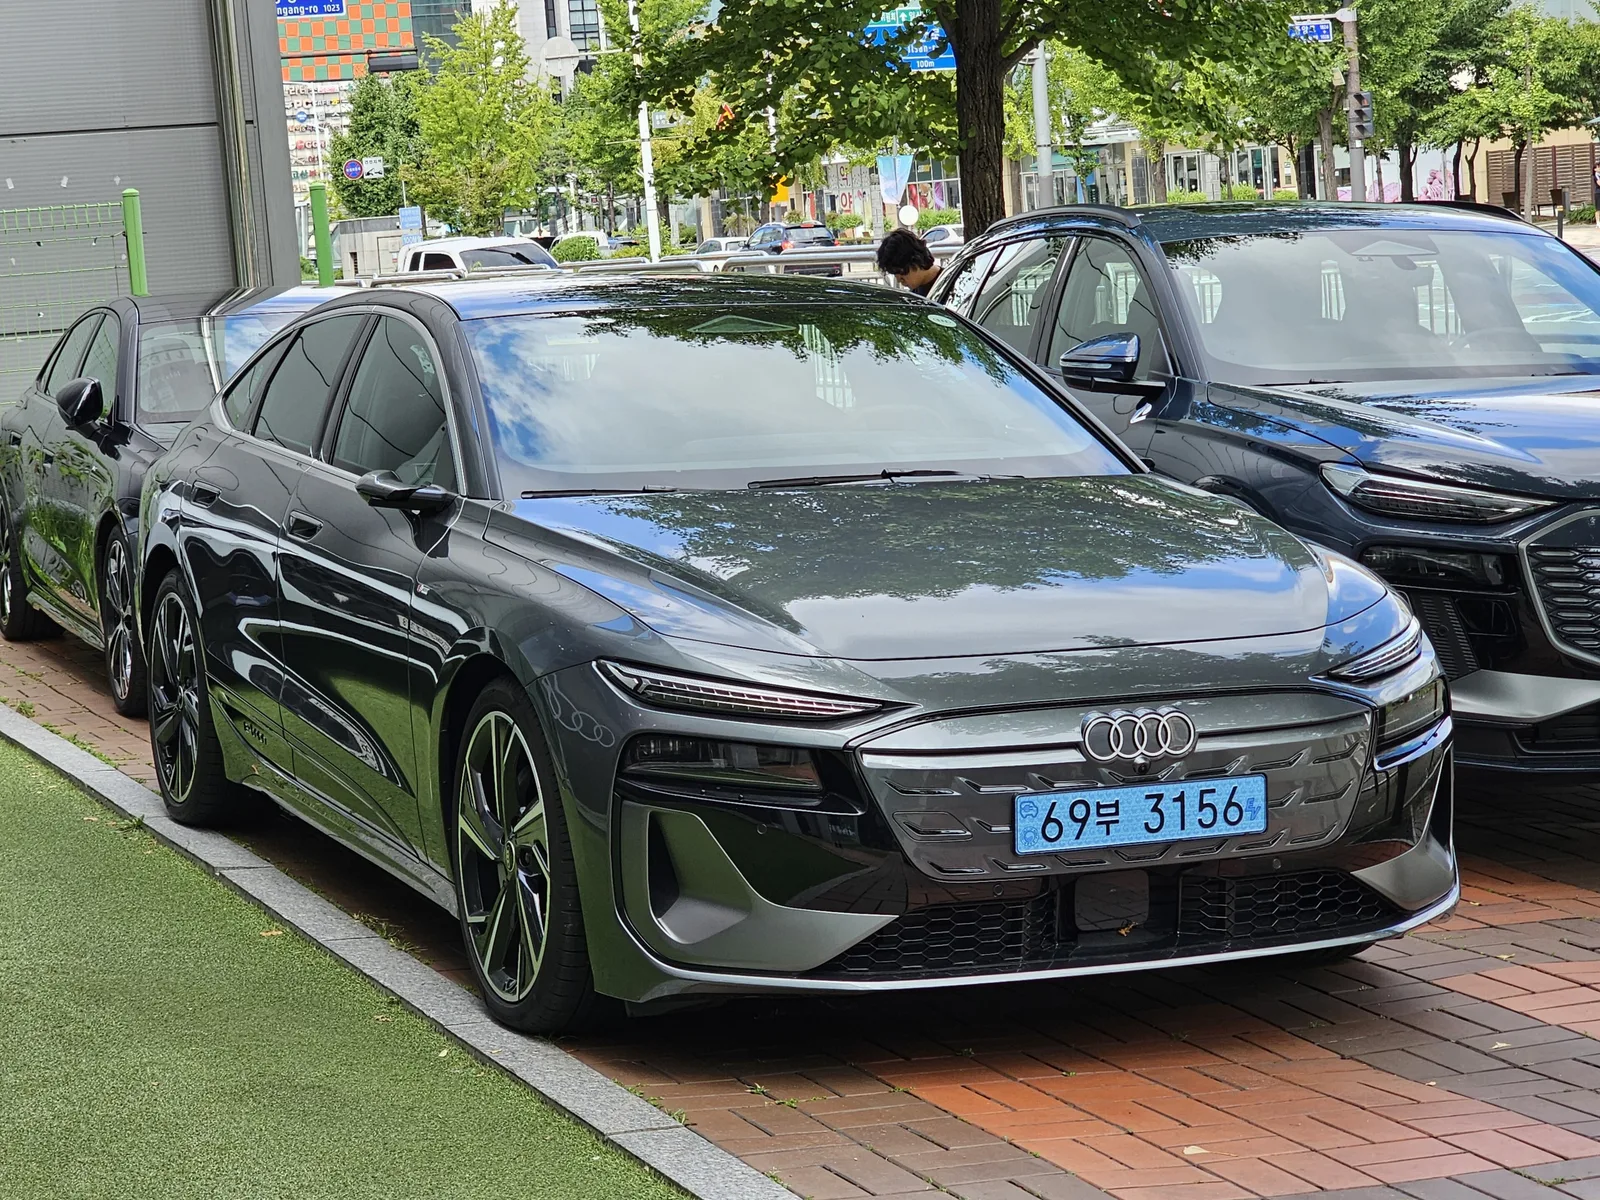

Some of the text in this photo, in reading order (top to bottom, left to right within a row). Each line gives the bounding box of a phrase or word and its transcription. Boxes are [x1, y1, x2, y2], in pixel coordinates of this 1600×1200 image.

[323, 4, 340, 12] 1023
[908, 43, 941, 53] Ilsan-r
[916, 60, 935, 68] 100m
[1041, 786, 1244, 843] 69부 3156
[1245, 797, 1262, 822] EV
